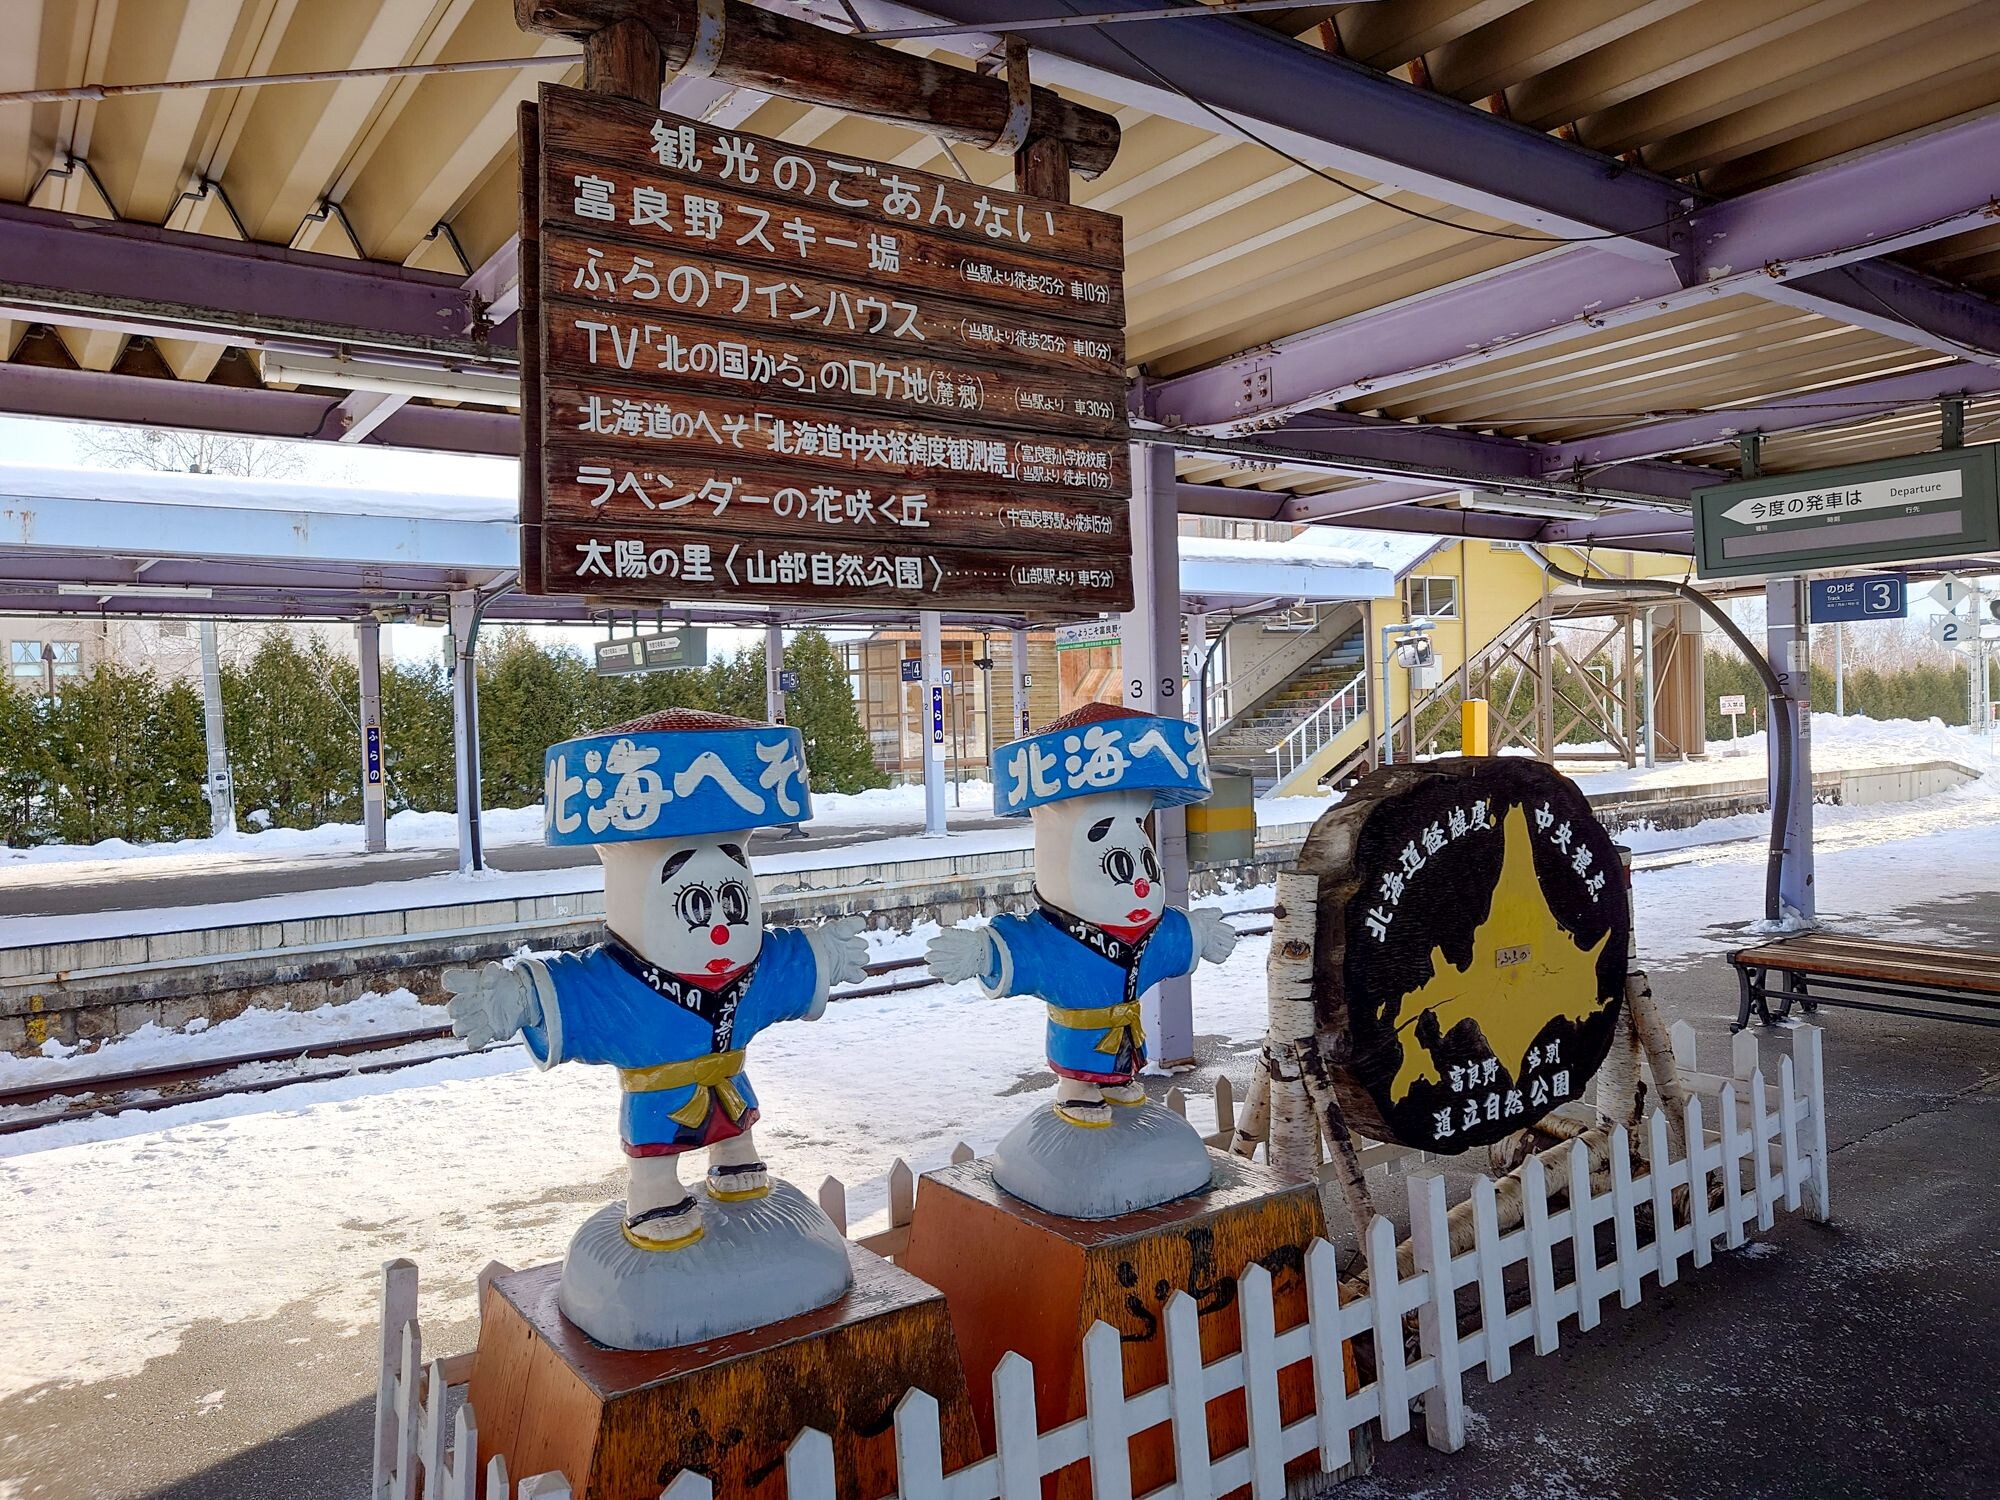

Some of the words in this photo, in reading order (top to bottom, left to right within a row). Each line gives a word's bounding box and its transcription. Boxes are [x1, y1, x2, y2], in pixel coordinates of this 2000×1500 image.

[650, 118, 1055, 243] 観光のごあんない
[574, 175, 899, 272] 富良野スキー場
[574, 248, 925, 340] ふらのワインハウス
[577, 466, 930, 528] ラベンダーの花咲く丘
[1750, 489, 1862, 519] 今度の発車は
[1890, 483, 1942, 498] Departure
[1905, 506, 1920, 514] 行先
[1827, 583, 1855, 594] のりば
[1872, 583, 1891, 610] 3
[1945, 582, 1953, 601] 1
[1943, 623, 1958, 641] 2
[913, 663, 920, 676] 4
[1193, 652, 1198, 667] 1
[790, 674, 796, 686] 5
[1131, 679, 1143, 699] 3
[1161, 677, 1175, 697] 3
[1777, 673, 1790, 686] 2
[925, 703, 929, 711] 2
[933, 690, 943, 742] ふらの
[368, 730, 379, 781] ふらの
[1448, 1057, 1499, 1092] 富良野
[1432, 1070, 1570, 1140] 道立自然公園
